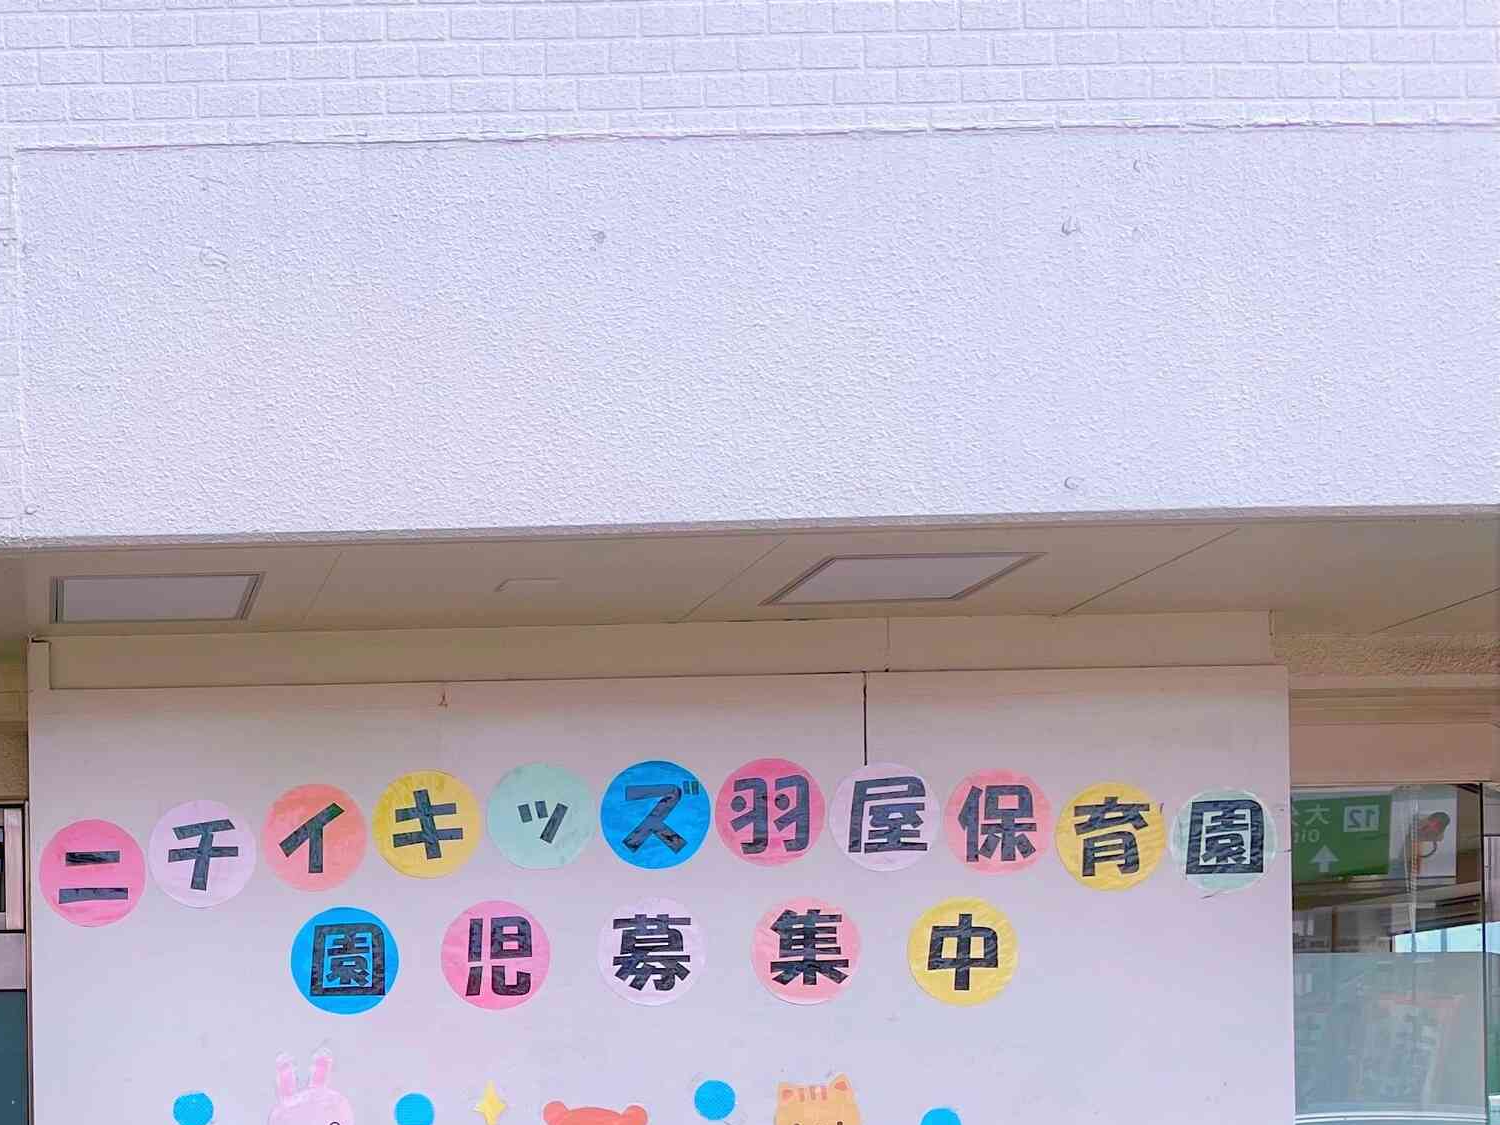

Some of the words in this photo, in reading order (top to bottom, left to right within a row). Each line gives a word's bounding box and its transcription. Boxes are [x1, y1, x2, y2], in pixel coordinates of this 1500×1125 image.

[57, 774, 1266, 905] ニチイキッズ羽屋保育園
[308, 908, 1000, 998] 園児募集中
